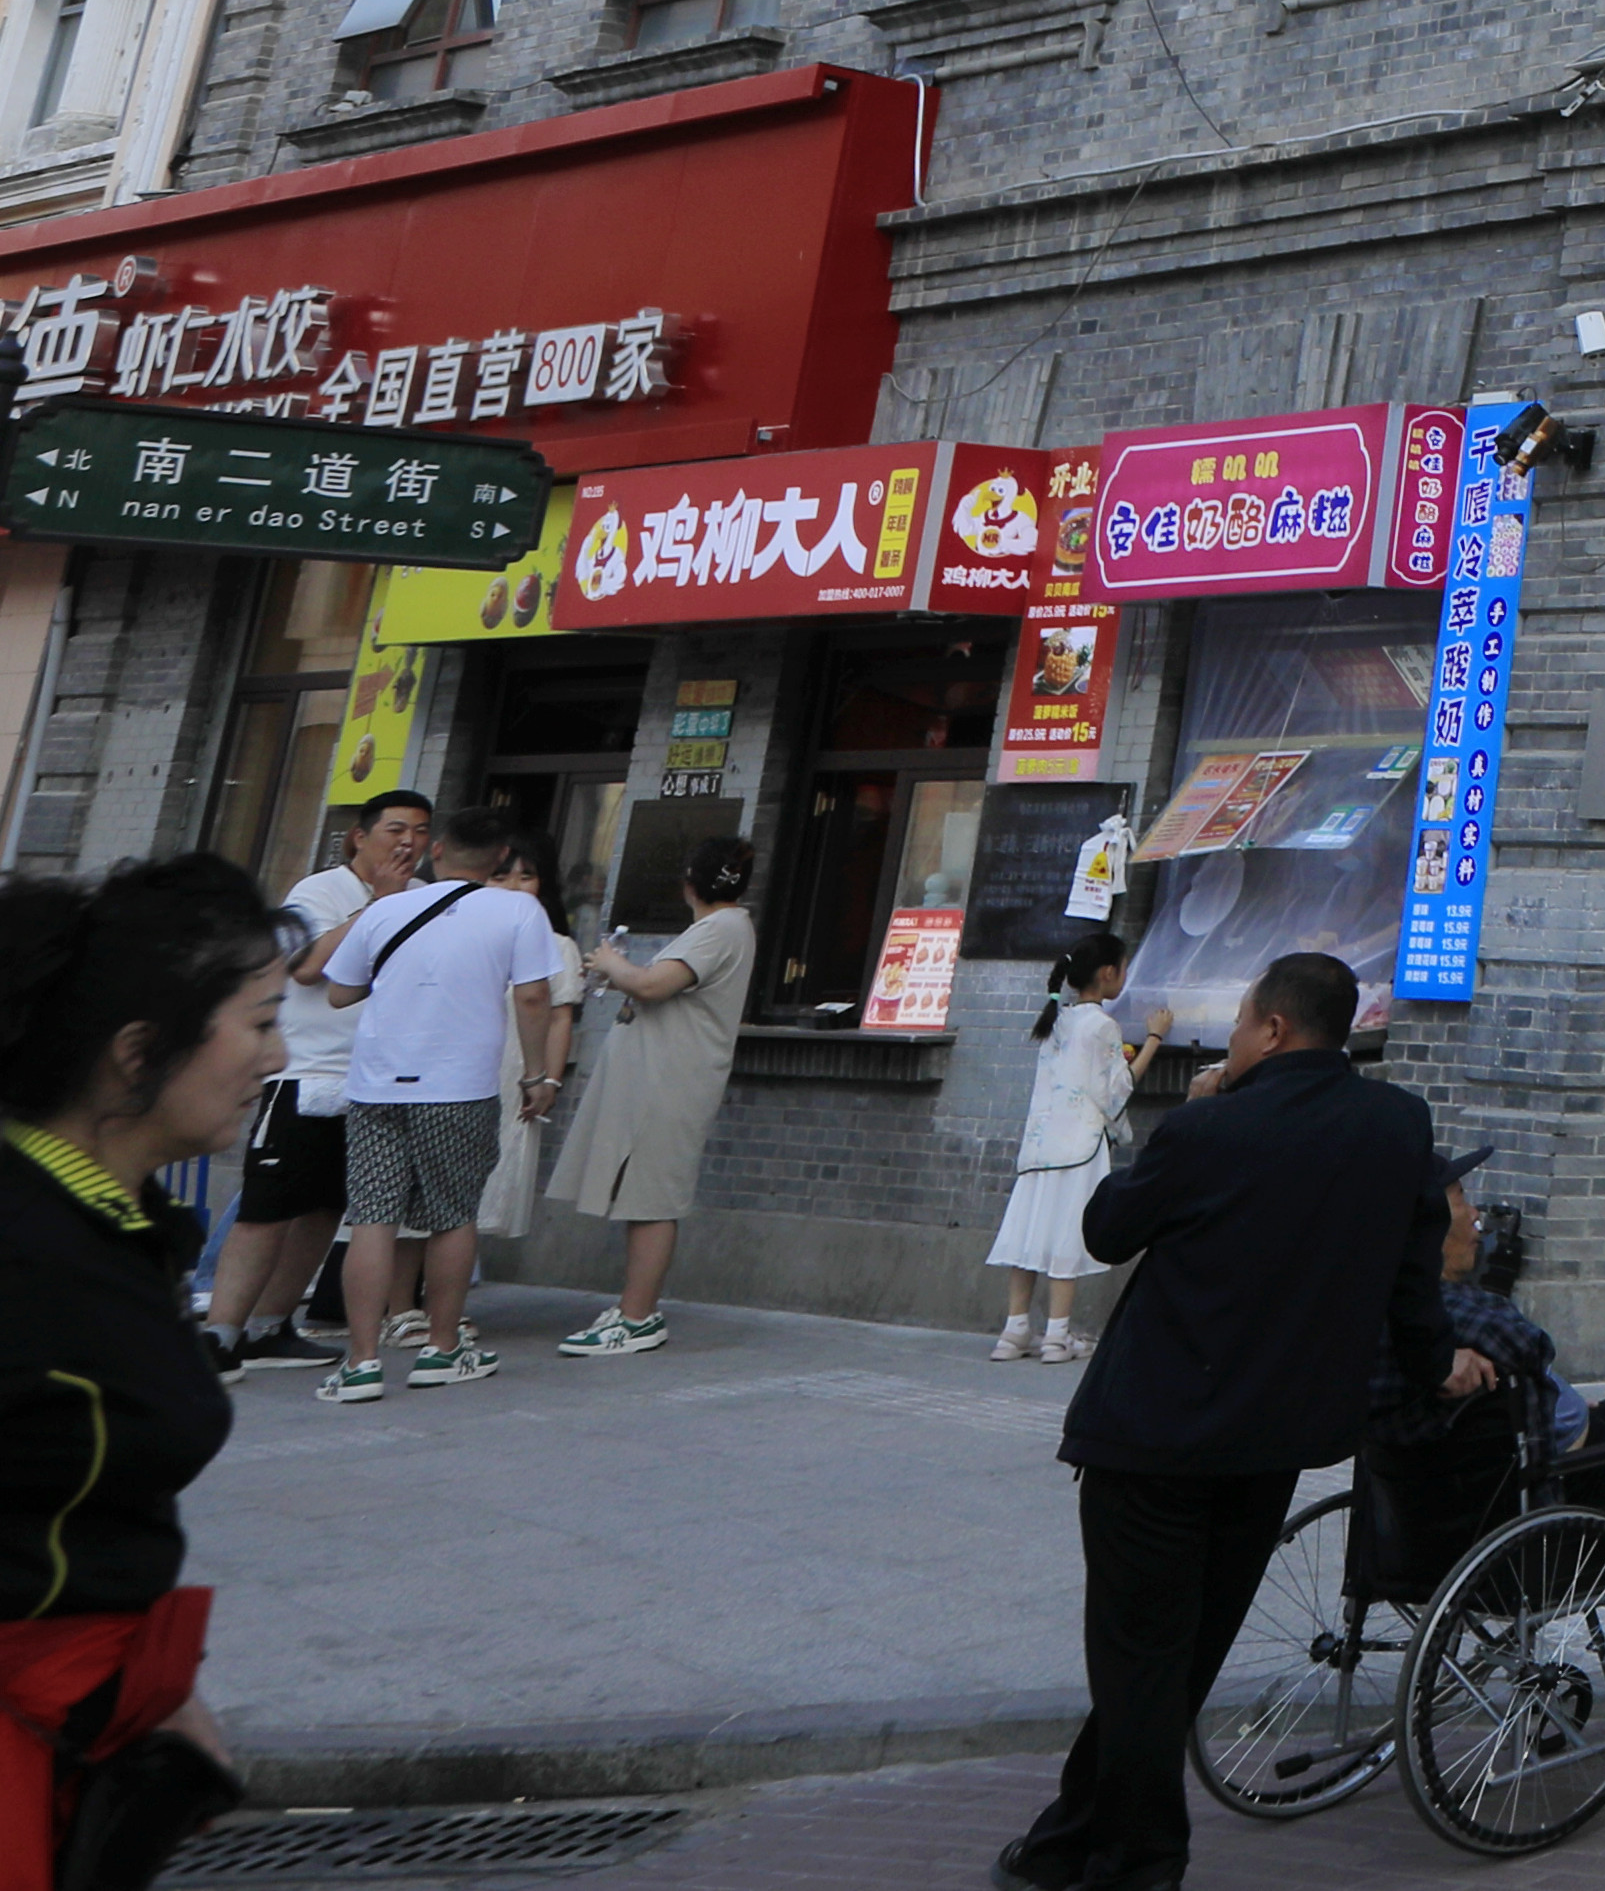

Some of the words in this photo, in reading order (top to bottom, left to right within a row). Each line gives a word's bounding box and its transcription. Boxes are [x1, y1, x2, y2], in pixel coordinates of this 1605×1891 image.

[110, 285, 318, 397] 虾仁水饺
[57, 489, 79, 509] N
[121, 499, 181, 519] nan
[196, 506, 232, 523] er
[249, 505, 304, 528] dao
[318, 510, 427, 538] Street
[470, 522, 485, 539] S
[63, 448, 93, 471] 北
[133, 437, 440, 504] 南二道街
[473, 483, 498, 504] 南
[632, 482, 868, 588] 鸡柳大人
[1107, 484, 1353, 560] 安佳奶酪麻糍
[942, 565, 1030, 590] 鸡柳大人
[1477, 600, 1505, 728] 手工制作
[1457, 755, 1486, 881] 真材实料
